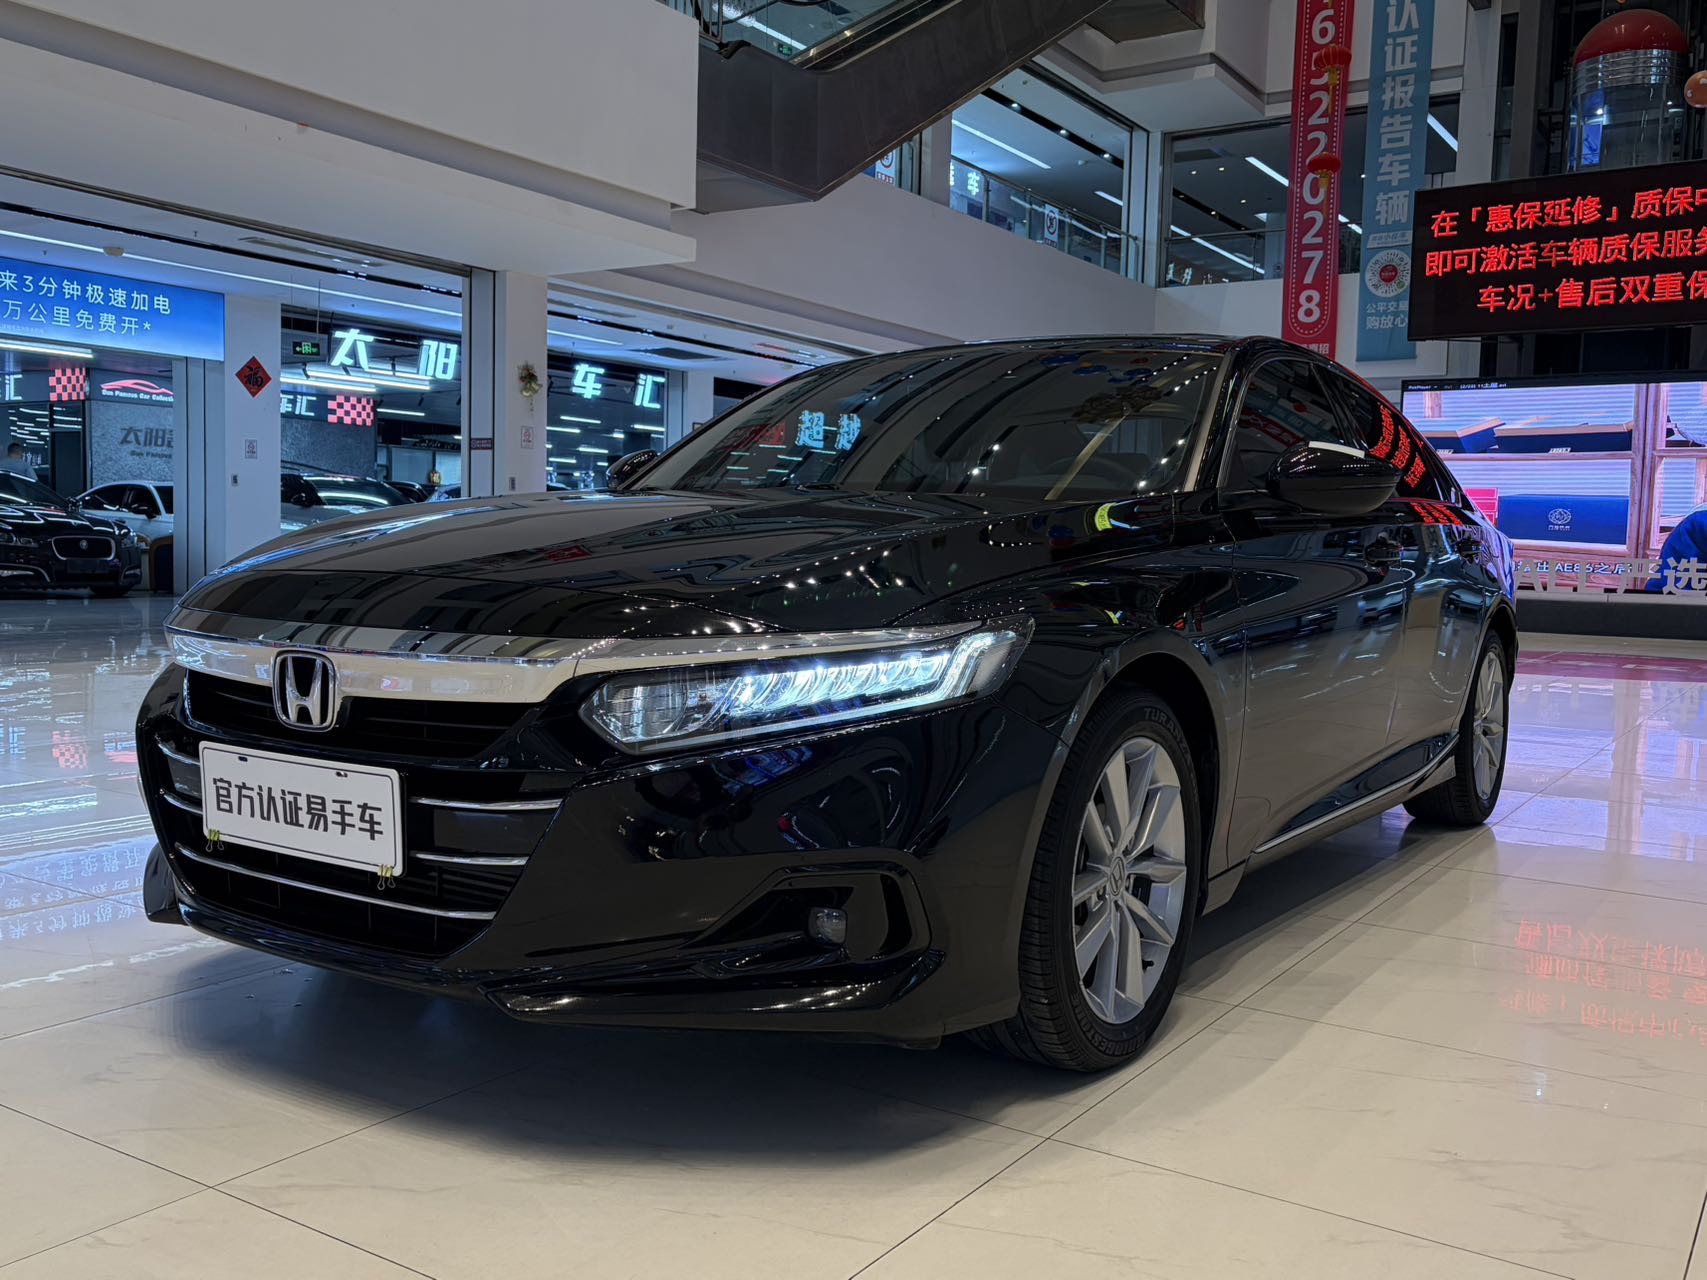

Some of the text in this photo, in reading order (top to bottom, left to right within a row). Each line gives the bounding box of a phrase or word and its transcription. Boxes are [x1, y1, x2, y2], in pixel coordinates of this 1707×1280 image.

[1375, 0, 1419, 225] 认证报告车辆
[1297, 0, 1335, 324] 65220278
[0, 269, 171, 315] 来3分钟极速加电
[245, 365, 266, 389] 福
[330, 328, 459, 381] 太阳
[0, 374, 23, 401] 汇
[571, 362, 666, 410] 车汇
[212, 777, 384, 841] 官方认证易手车
